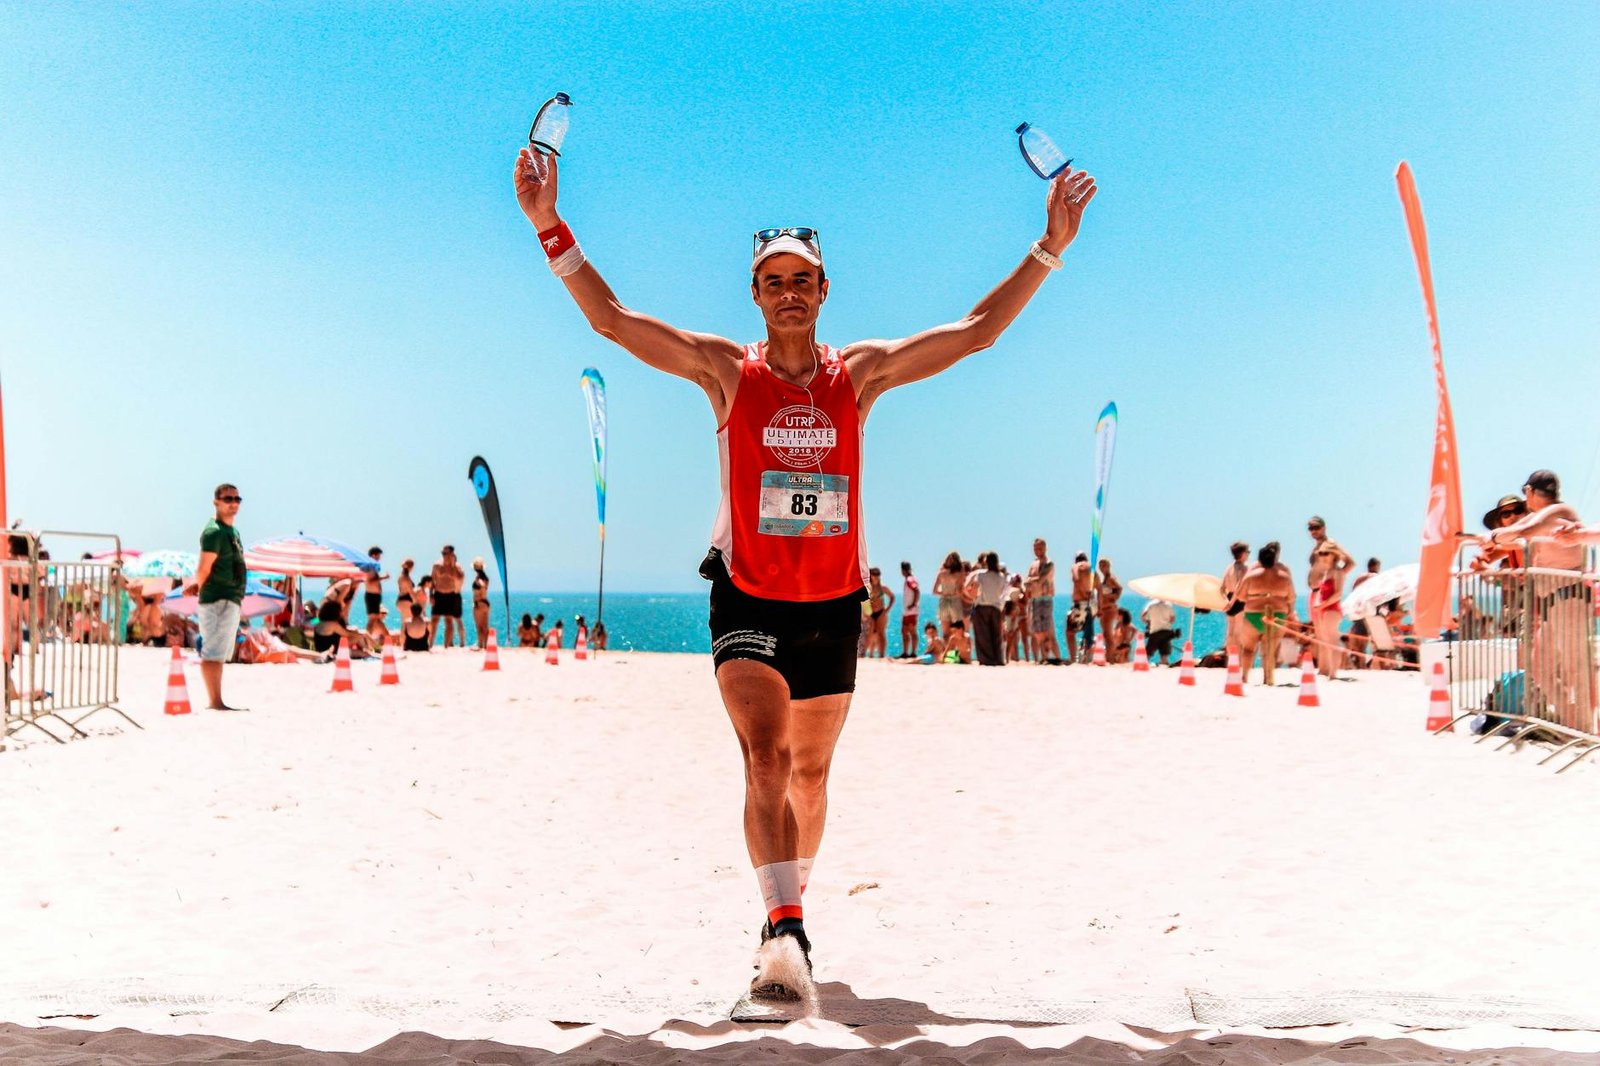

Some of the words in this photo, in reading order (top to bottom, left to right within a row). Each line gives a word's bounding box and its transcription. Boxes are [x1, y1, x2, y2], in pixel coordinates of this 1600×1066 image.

[785, 416, 816, 427] UTRP
[767, 429, 834, 439] ULTIMATE
[766, 438, 834, 446] EDITION
[791, 493, 818, 516] 83
